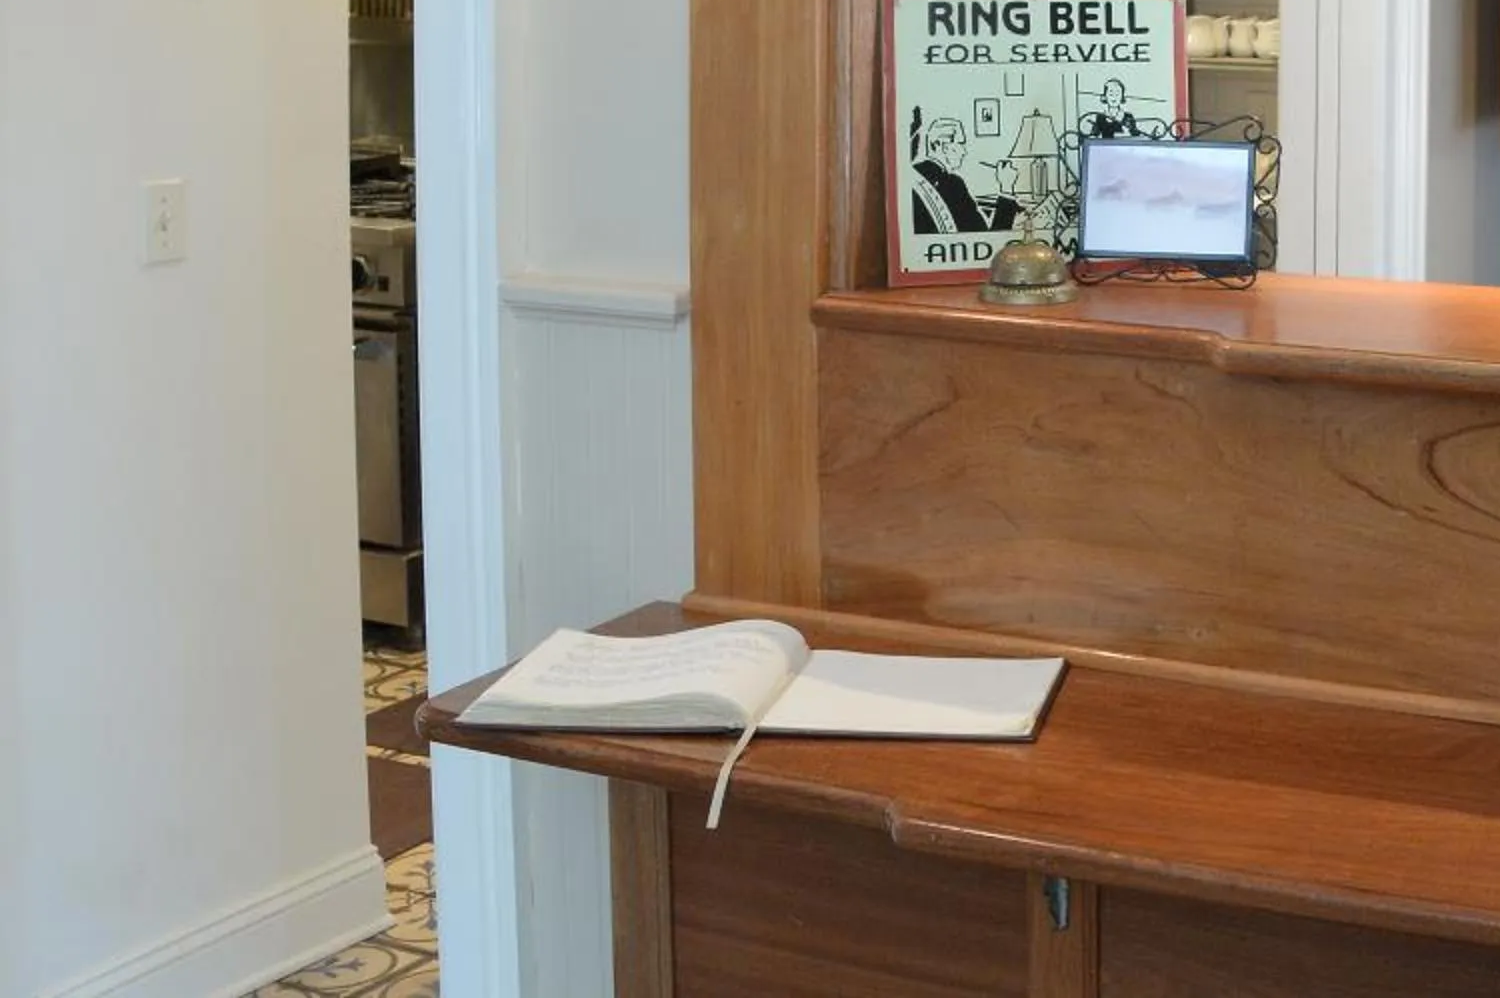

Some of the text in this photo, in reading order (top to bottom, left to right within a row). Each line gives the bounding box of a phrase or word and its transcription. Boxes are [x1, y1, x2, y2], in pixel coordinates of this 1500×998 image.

[928, 1, 1150, 36] RING BELL
[924, 43, 1151, 64] FOR SERVICE
[924, 241, 993, 263] AND
